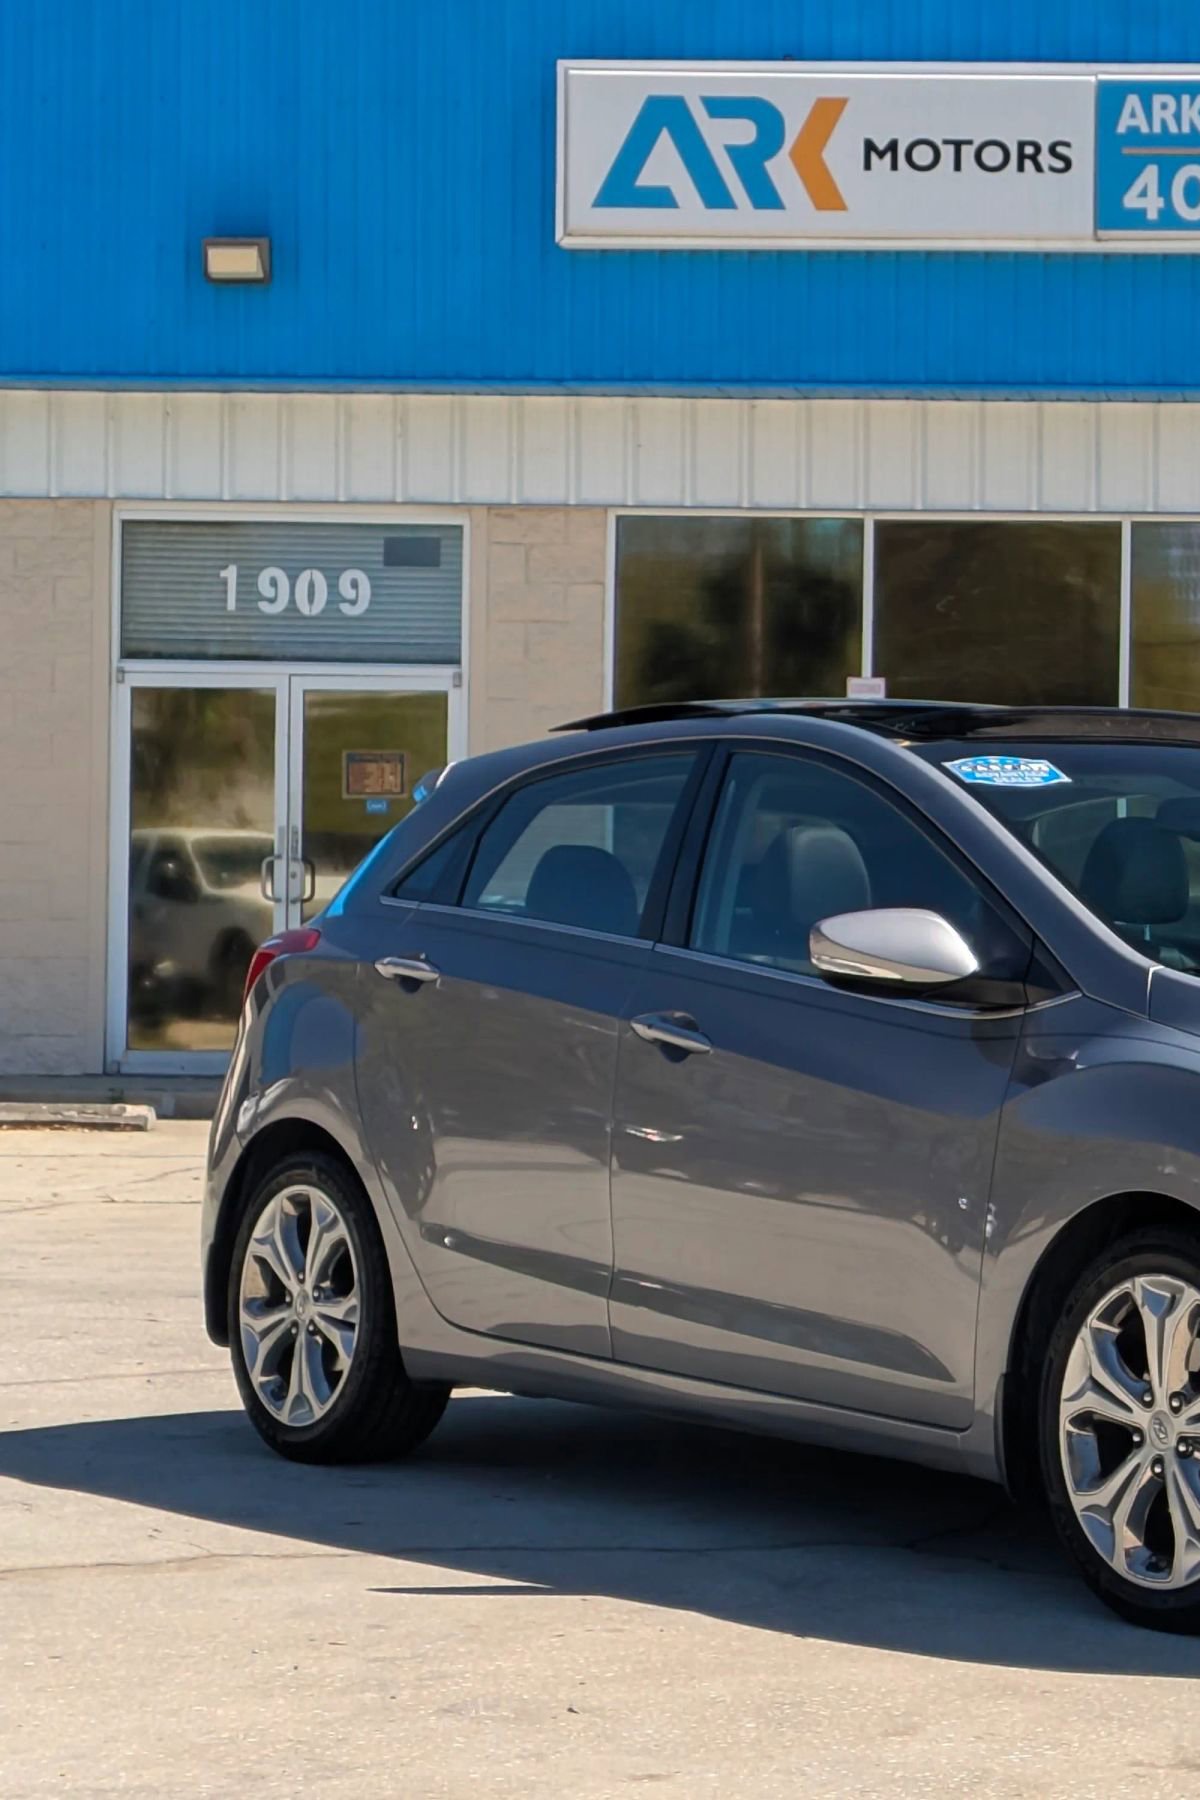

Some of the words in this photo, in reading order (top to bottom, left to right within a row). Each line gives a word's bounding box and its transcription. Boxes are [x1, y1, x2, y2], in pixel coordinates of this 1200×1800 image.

[591, 95, 850, 211] ARK
[863, 137, 1073, 174] MOTORS
[219, 564, 372, 616] 1909
